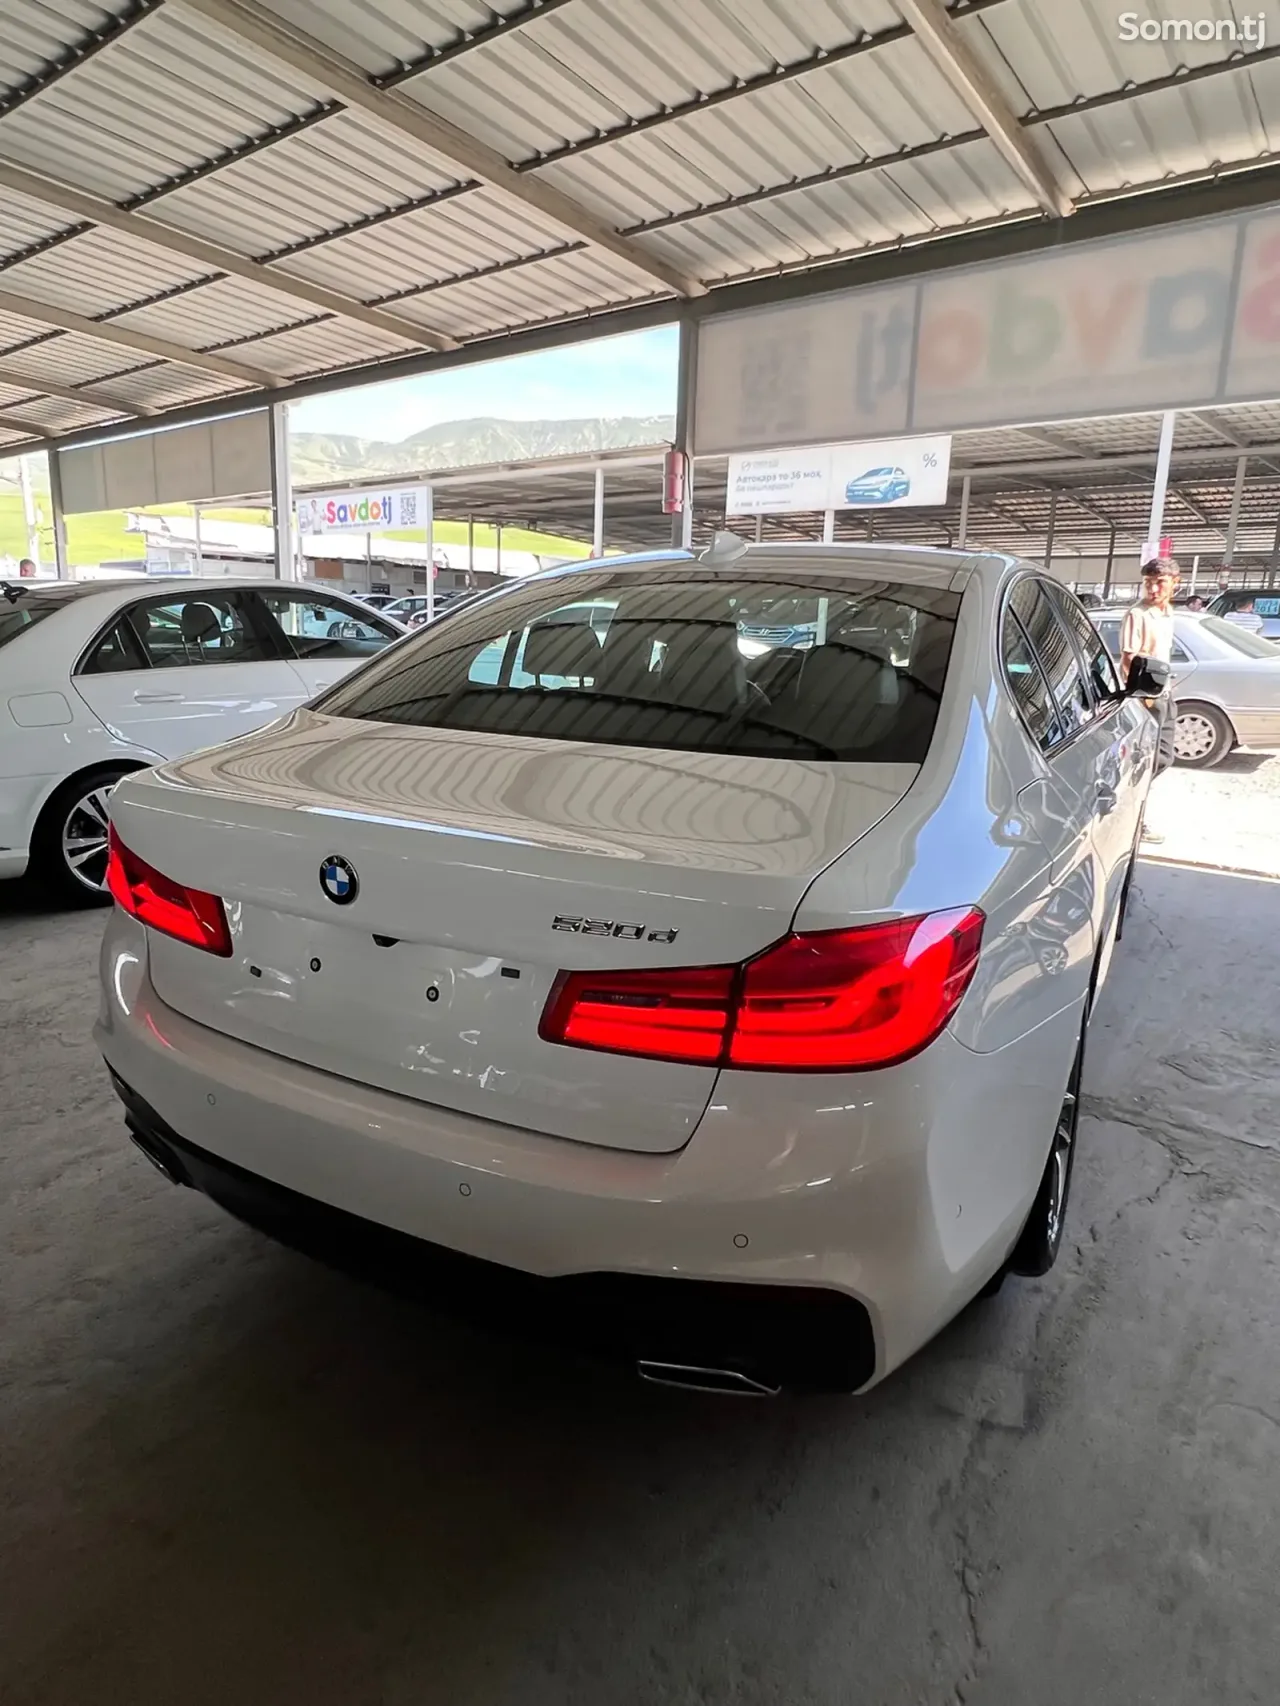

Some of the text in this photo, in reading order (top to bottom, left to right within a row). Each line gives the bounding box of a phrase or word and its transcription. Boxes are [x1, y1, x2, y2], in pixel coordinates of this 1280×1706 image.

[923, 453, 937, 468] %
[327, 496, 392, 524] Savdo.tj
[551, 913, 681, 944] 520d
